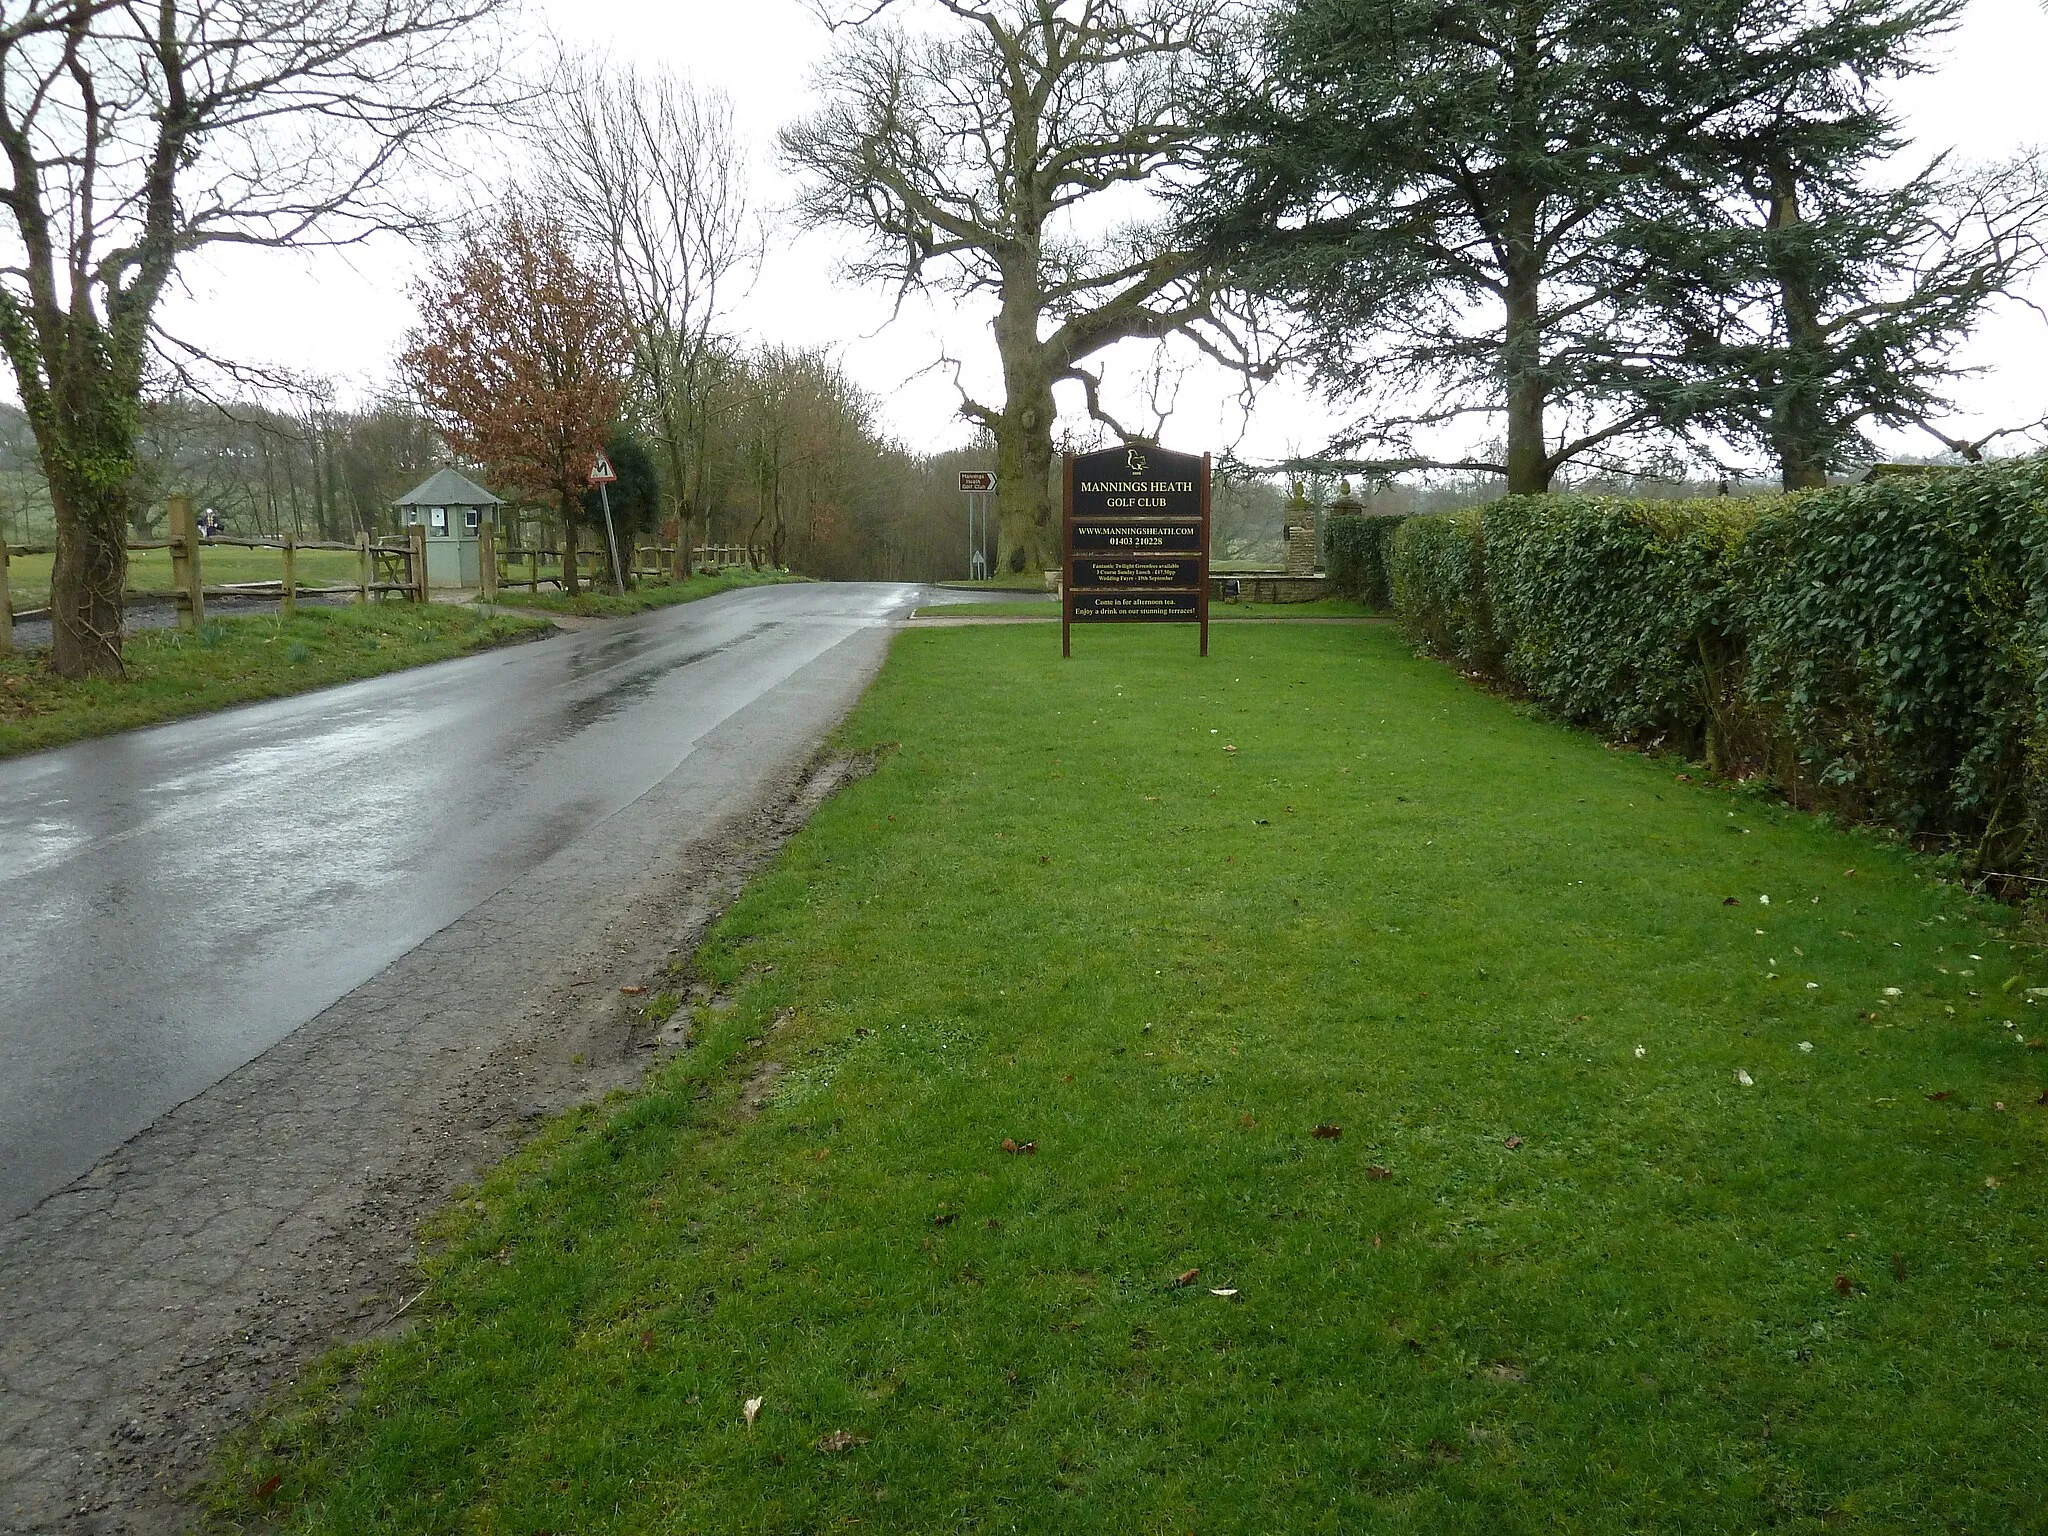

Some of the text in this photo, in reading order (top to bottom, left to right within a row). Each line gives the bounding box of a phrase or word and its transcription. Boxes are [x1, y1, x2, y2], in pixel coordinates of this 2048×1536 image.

[1081, 482, 1192, 492] MANNINGS HEATH
[1107, 498, 1166, 507] GOLF CLUB
